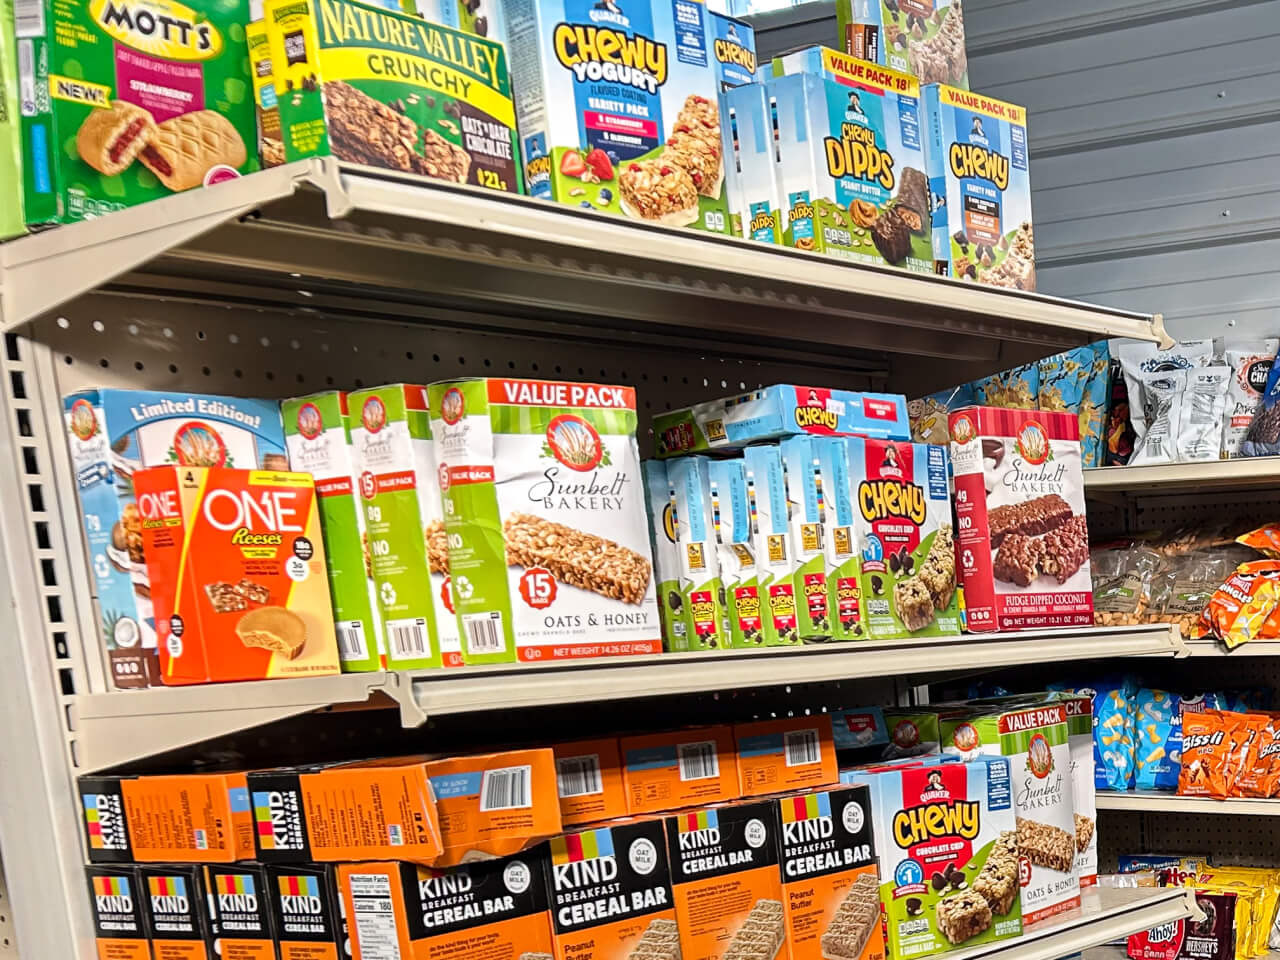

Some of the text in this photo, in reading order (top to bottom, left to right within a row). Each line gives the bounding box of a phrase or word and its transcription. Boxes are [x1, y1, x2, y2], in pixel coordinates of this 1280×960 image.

[103, 1, 211, 50] MOTT'S
[321, 0, 501, 90] NATURE VALLEY
[554, 22, 668, 86] CHEWY
[714, 38, 756, 75] CHEWY
[368, 54, 472, 98] CRUNCHY
[572, 61, 659, 95] YOGURT
[830, 56, 893, 88] VALUE PACK
[947, 88, 1005, 118] VALUE PACK
[841, 121, 877, 149] CHEWY
[824, 134, 896, 190] DIPPS
[949, 142, 1010, 192] CHEWY
[504, 381, 627, 407] VALUE PACK
[129, 397, 262, 430] Limited Edition!
[794, 405, 839, 432] CHEWY
[528, 466, 633, 503] Sunbelt
[1003, 458, 1066, 487] Sunbelt
[857, 478, 928, 526] CHEWY
[1011, 482, 1064, 494] BAKERY
[139, 490, 181, 518] ONE
[203, 488, 304, 533] ONE
[543, 496, 625, 512] BAKERY
[371, 540, 390, 556] NO
[525, 573, 551, 598] 15
[1005, 593, 1087, 606] FUDGE DIPPED COCONUT
[544, 612, 649, 628] OATS & HONEY
[1007, 708, 1062, 732] VALUE PACK
[1181, 730, 1225, 752] Bissli
[1016, 776, 1064, 809] Sunbelt
[1022, 792, 1063, 812] BAKERY
[96, 794, 116, 850] KIND
[268, 791, 290, 850] KIND
[782, 816, 835, 847] KIND
[893, 800, 980, 849] CHEWY
[678, 828, 721, 852] KIND
[681, 845, 723, 860] BREAKFAST
[785, 839, 836, 858] BREAKFAST
[553, 856, 619, 892] KIND
[682, 849, 754, 876] CEREAL BAR
[785, 844, 872, 877] CEREAL BAR
[418, 872, 473, 901] KIND
[557, 882, 621, 905] BREAKFAST
[789, 888, 816, 901] Peanut
[1026, 885, 1046, 901] OATS
[96, 894, 134, 913] KIND
[151, 894, 190, 913] KIND
[219, 893, 259, 913] KIND
[281, 895, 323, 914] KIND
[420, 893, 475, 911] BREAKFAST
[422, 895, 515, 929] CEREAL BAR
[558, 893, 631, 927] CEREAL
[631, 885, 668, 909] BAR
[790, 898, 813, 911] Butter
[564, 938, 596, 954] Peanut
